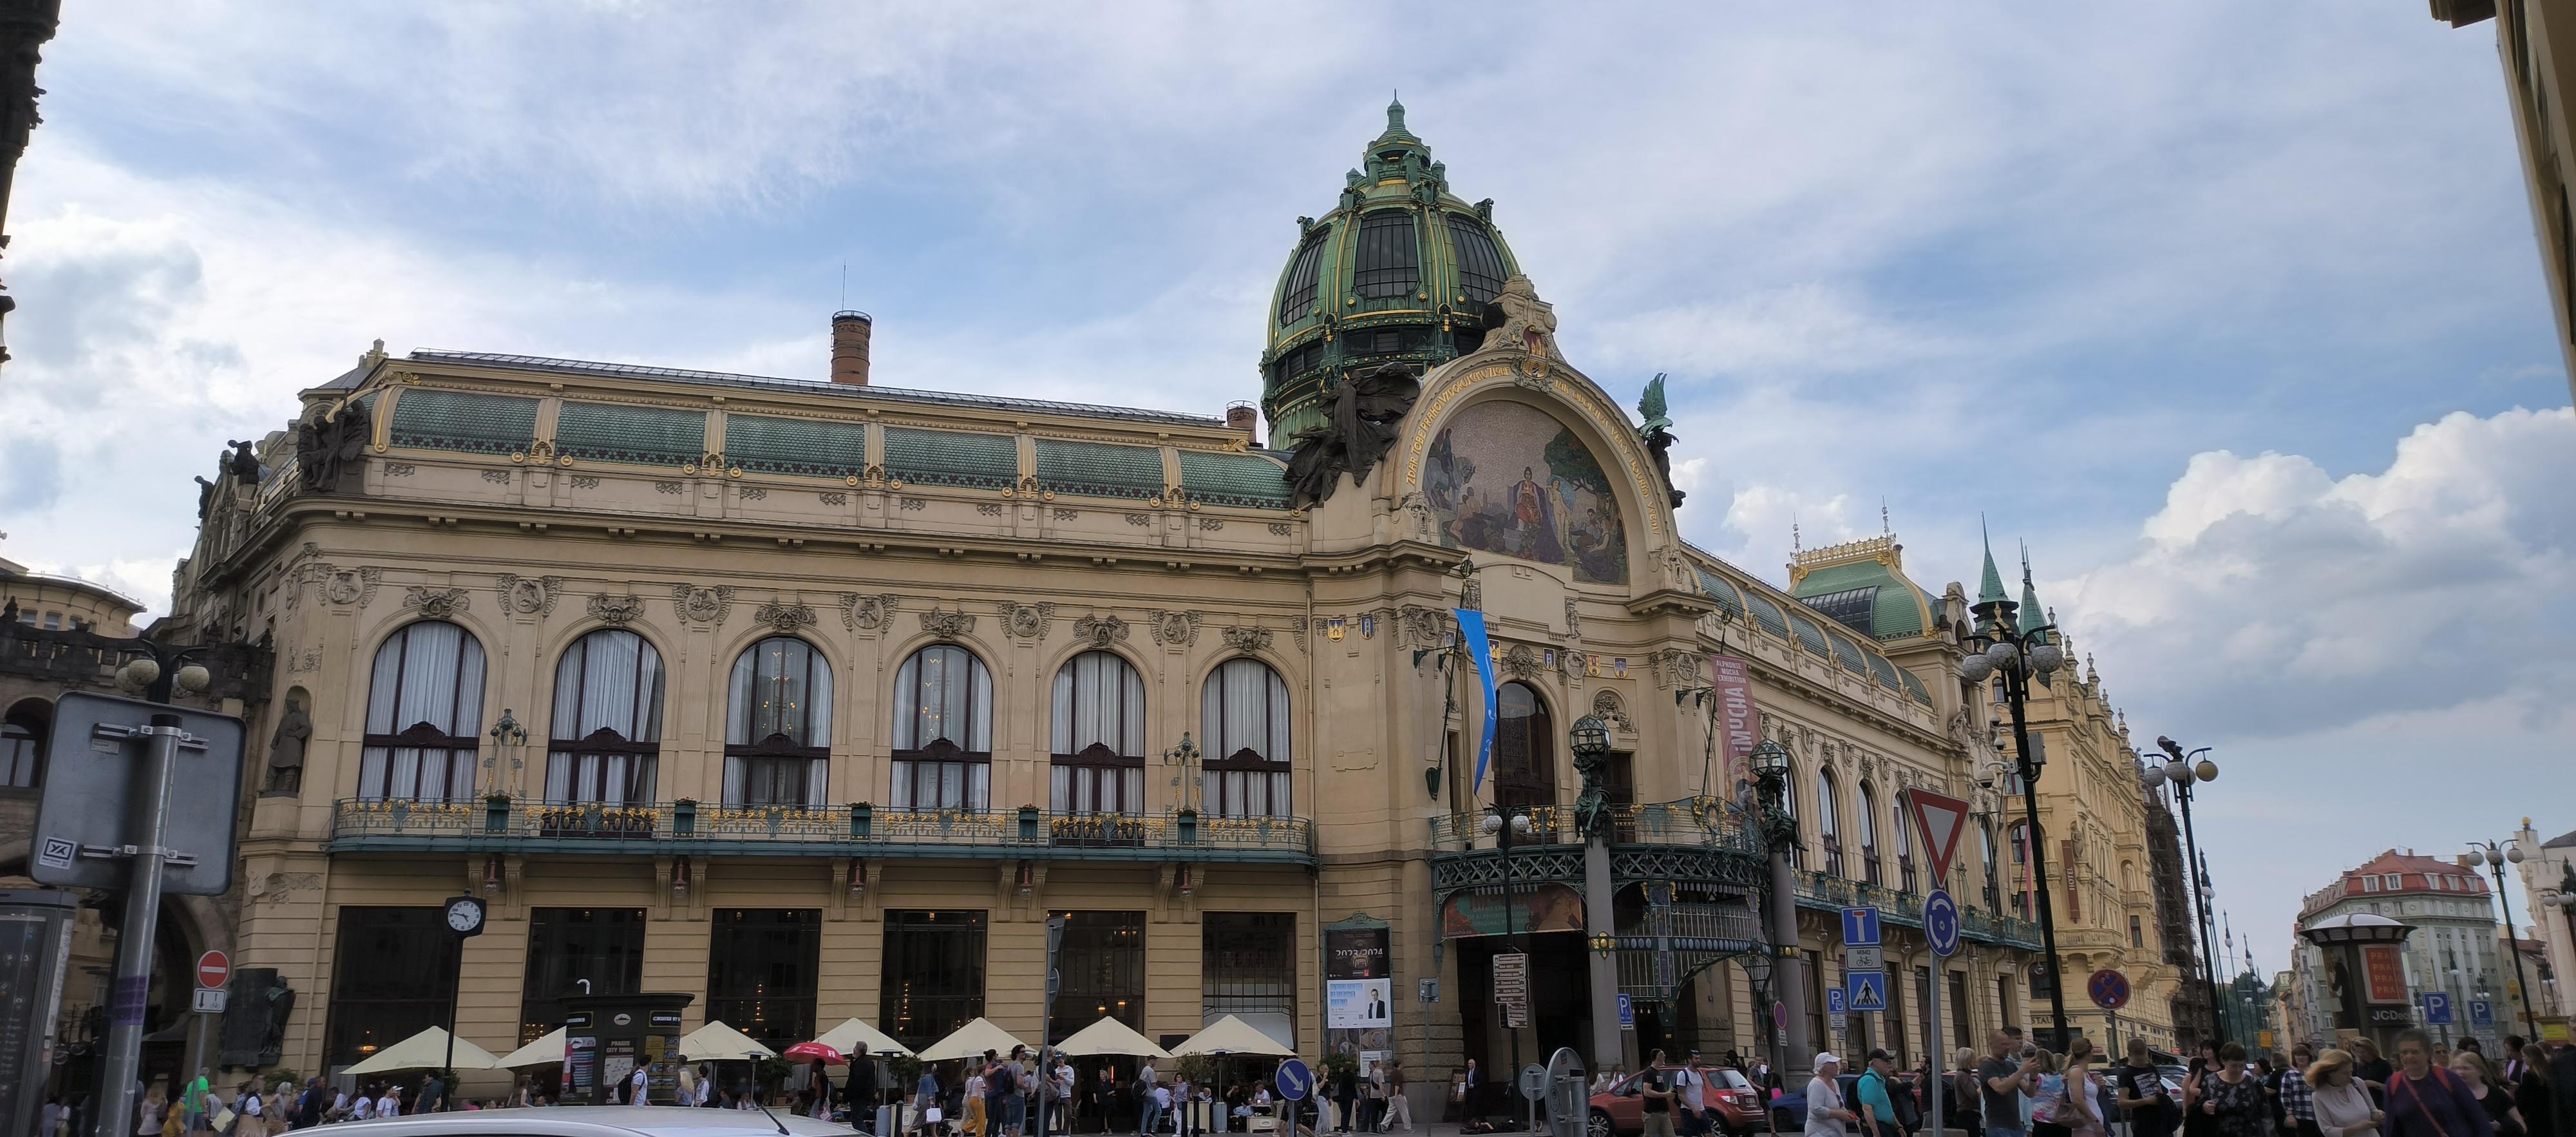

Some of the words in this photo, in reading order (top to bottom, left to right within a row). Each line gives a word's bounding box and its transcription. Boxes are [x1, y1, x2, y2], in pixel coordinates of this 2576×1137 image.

[1716, 660, 1742, 670] ALPHONSE
[1721, 667, 1740, 676] MUCHA
[1717, 674, 1747, 684] EXHIBITION
[1724, 687, 1754, 752] iMUCHA
[1619, 997, 1628, 1014] P
[1831, 991, 1841, 1005] P
[2429, 996, 2444, 1015] P
[2474, 1002, 2486, 1018] P
